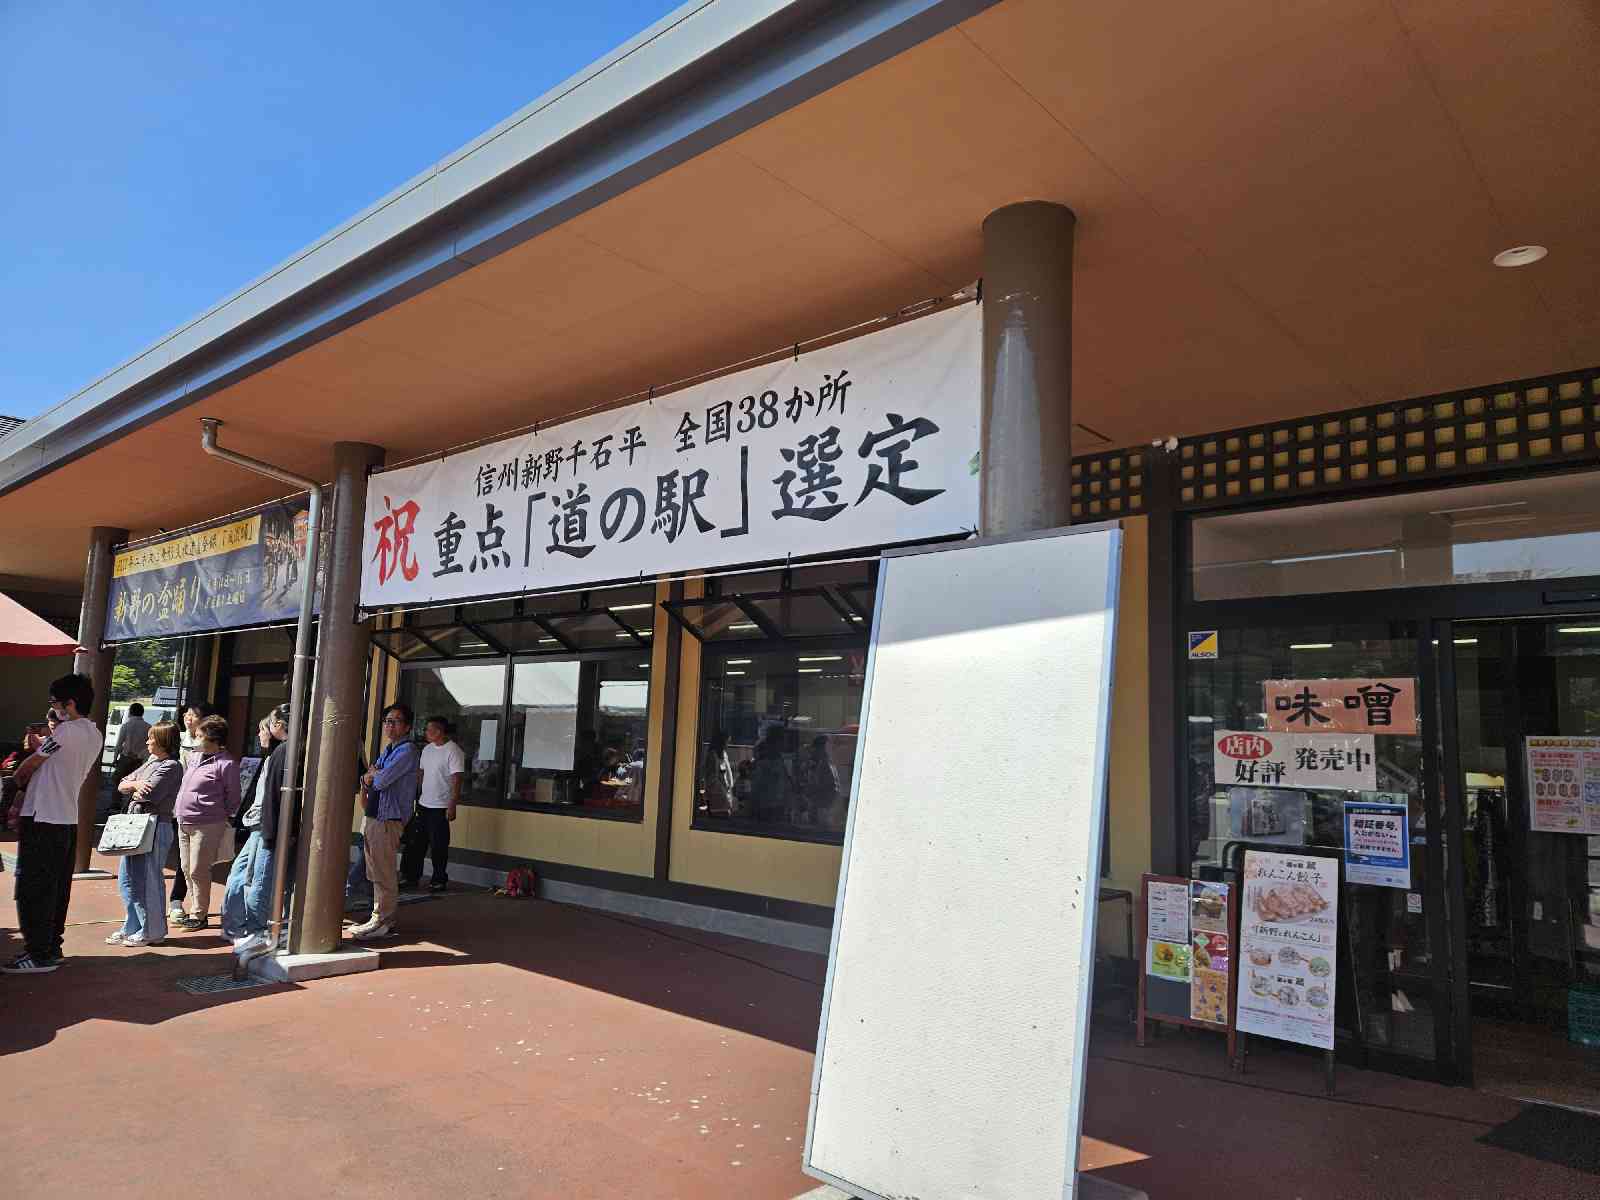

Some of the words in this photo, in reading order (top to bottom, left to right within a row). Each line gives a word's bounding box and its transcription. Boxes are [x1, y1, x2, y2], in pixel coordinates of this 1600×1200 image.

[475, 426, 647, 497] 信州新野千石平
[676, 370, 852, 453] 全国38か所
[373, 495, 421, 586] 祝
[1227, 735, 1265, 756] 店内
[1235, 759, 1287, 784] 好評
[1295, 747, 1371, 772] 発売中
